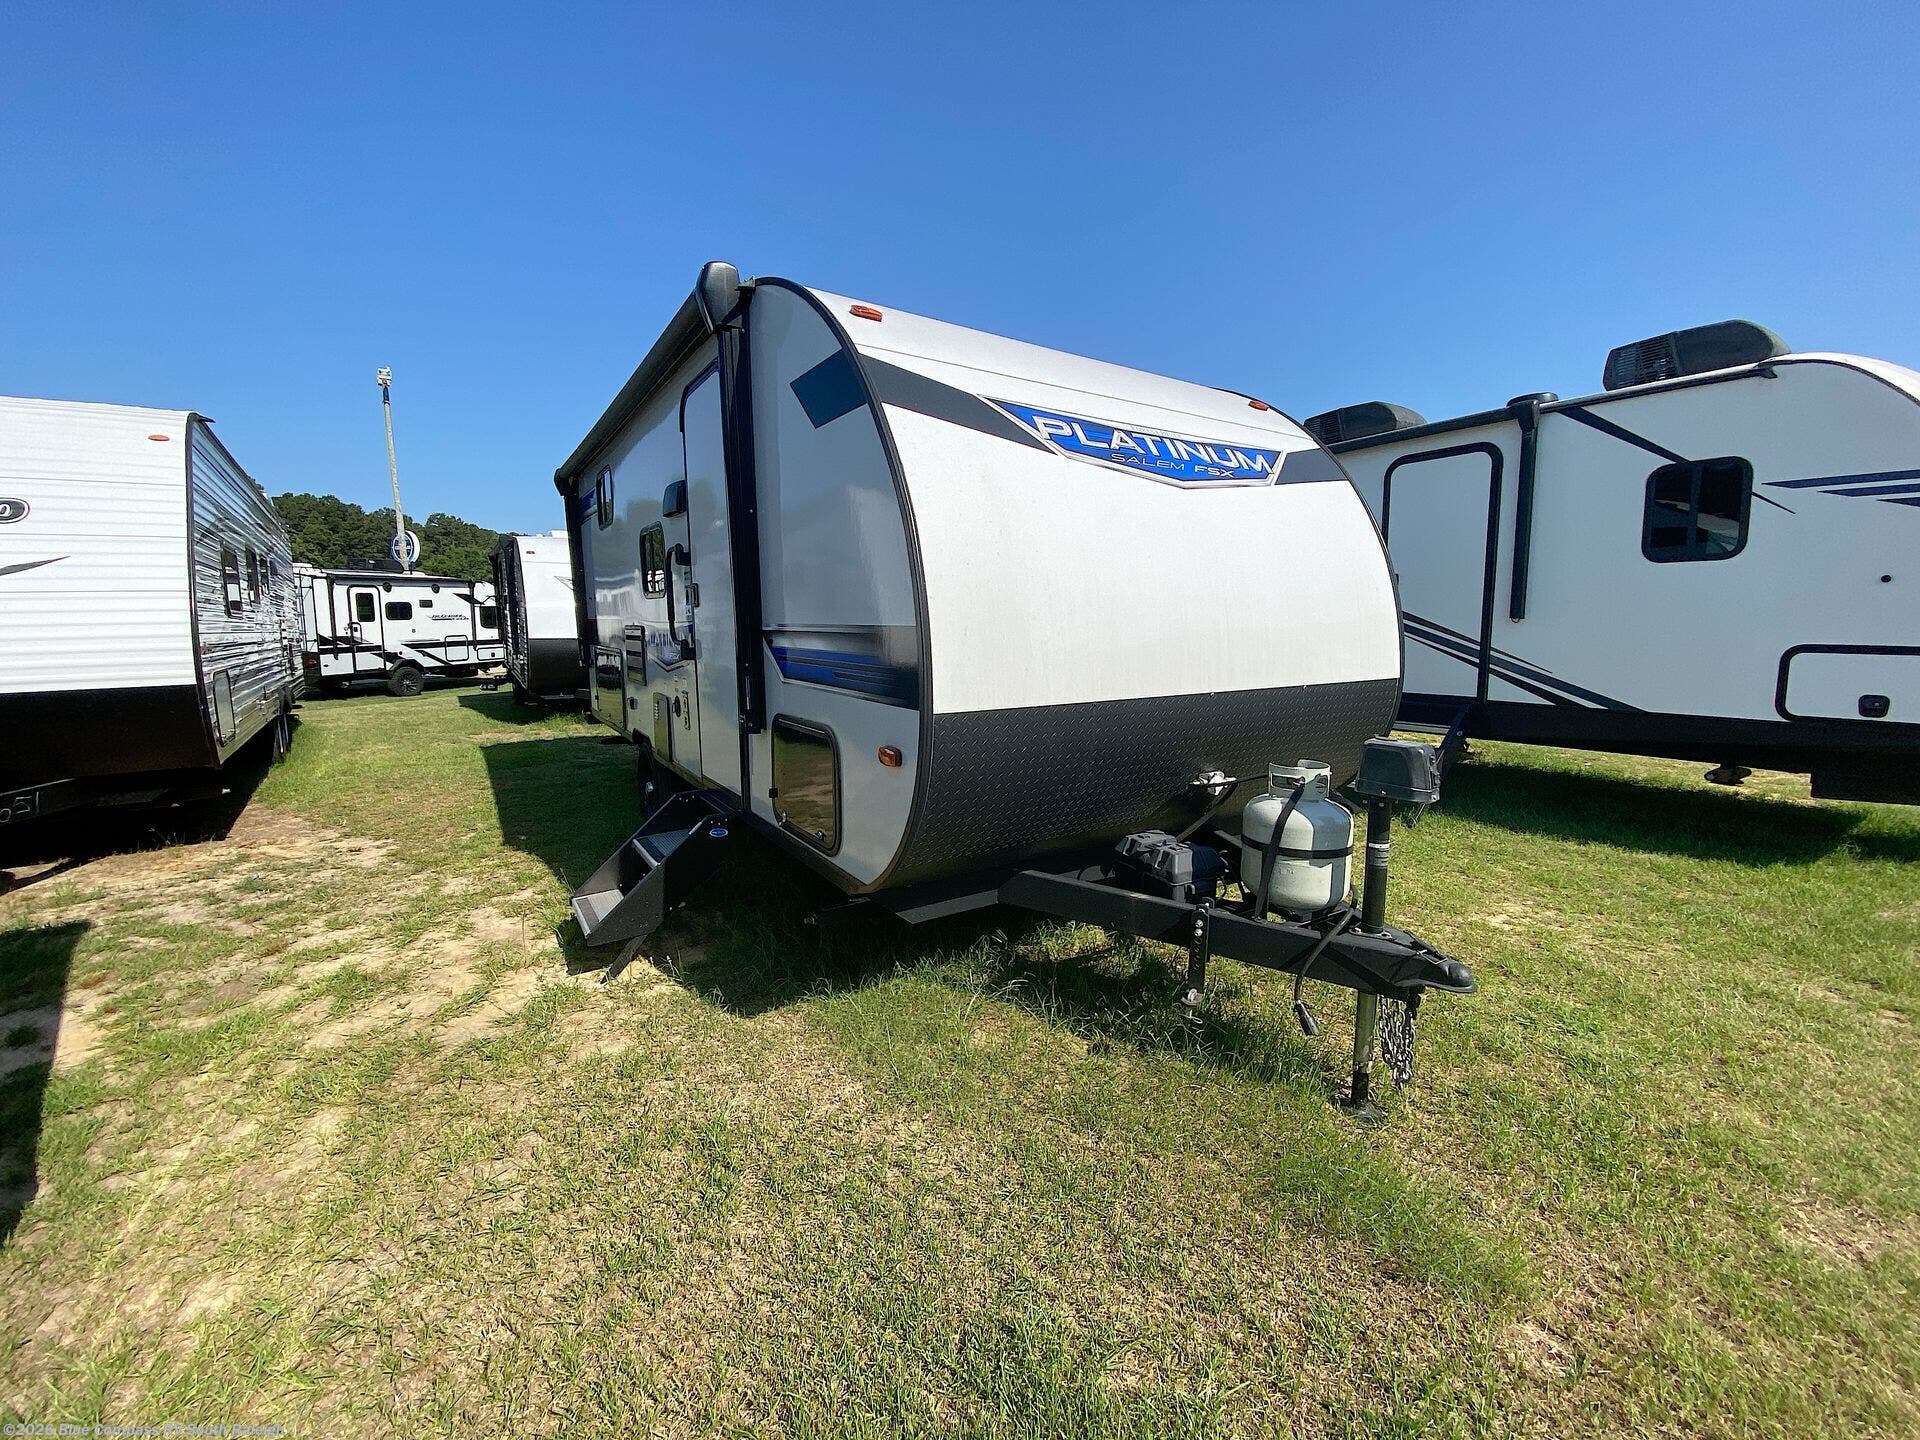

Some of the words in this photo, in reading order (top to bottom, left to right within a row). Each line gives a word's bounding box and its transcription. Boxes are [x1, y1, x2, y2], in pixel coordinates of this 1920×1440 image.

[1032, 415, 1275, 474] PLATINUM
[1111, 453, 1185, 471] SALEM
[1194, 465, 1235, 478] FSX
